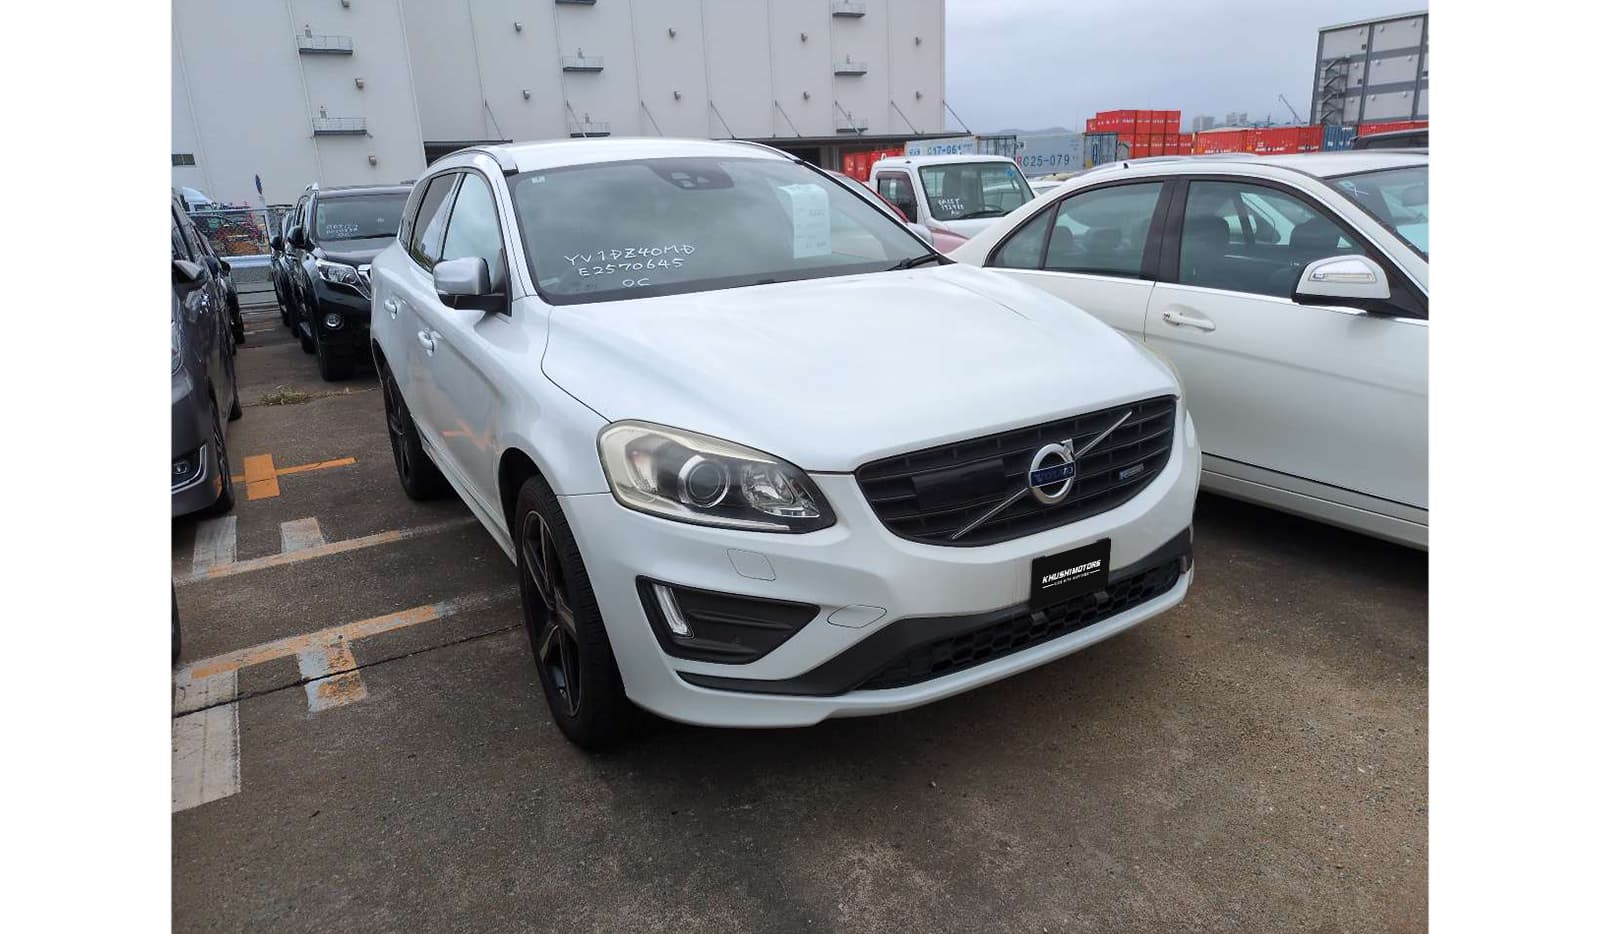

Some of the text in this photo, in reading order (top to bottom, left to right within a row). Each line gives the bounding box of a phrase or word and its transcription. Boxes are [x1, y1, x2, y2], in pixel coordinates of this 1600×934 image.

[564, 244, 695, 266] YV1DZ40MD
[578, 258, 686, 276] E2570645
[622, 278, 651, 287] OC
